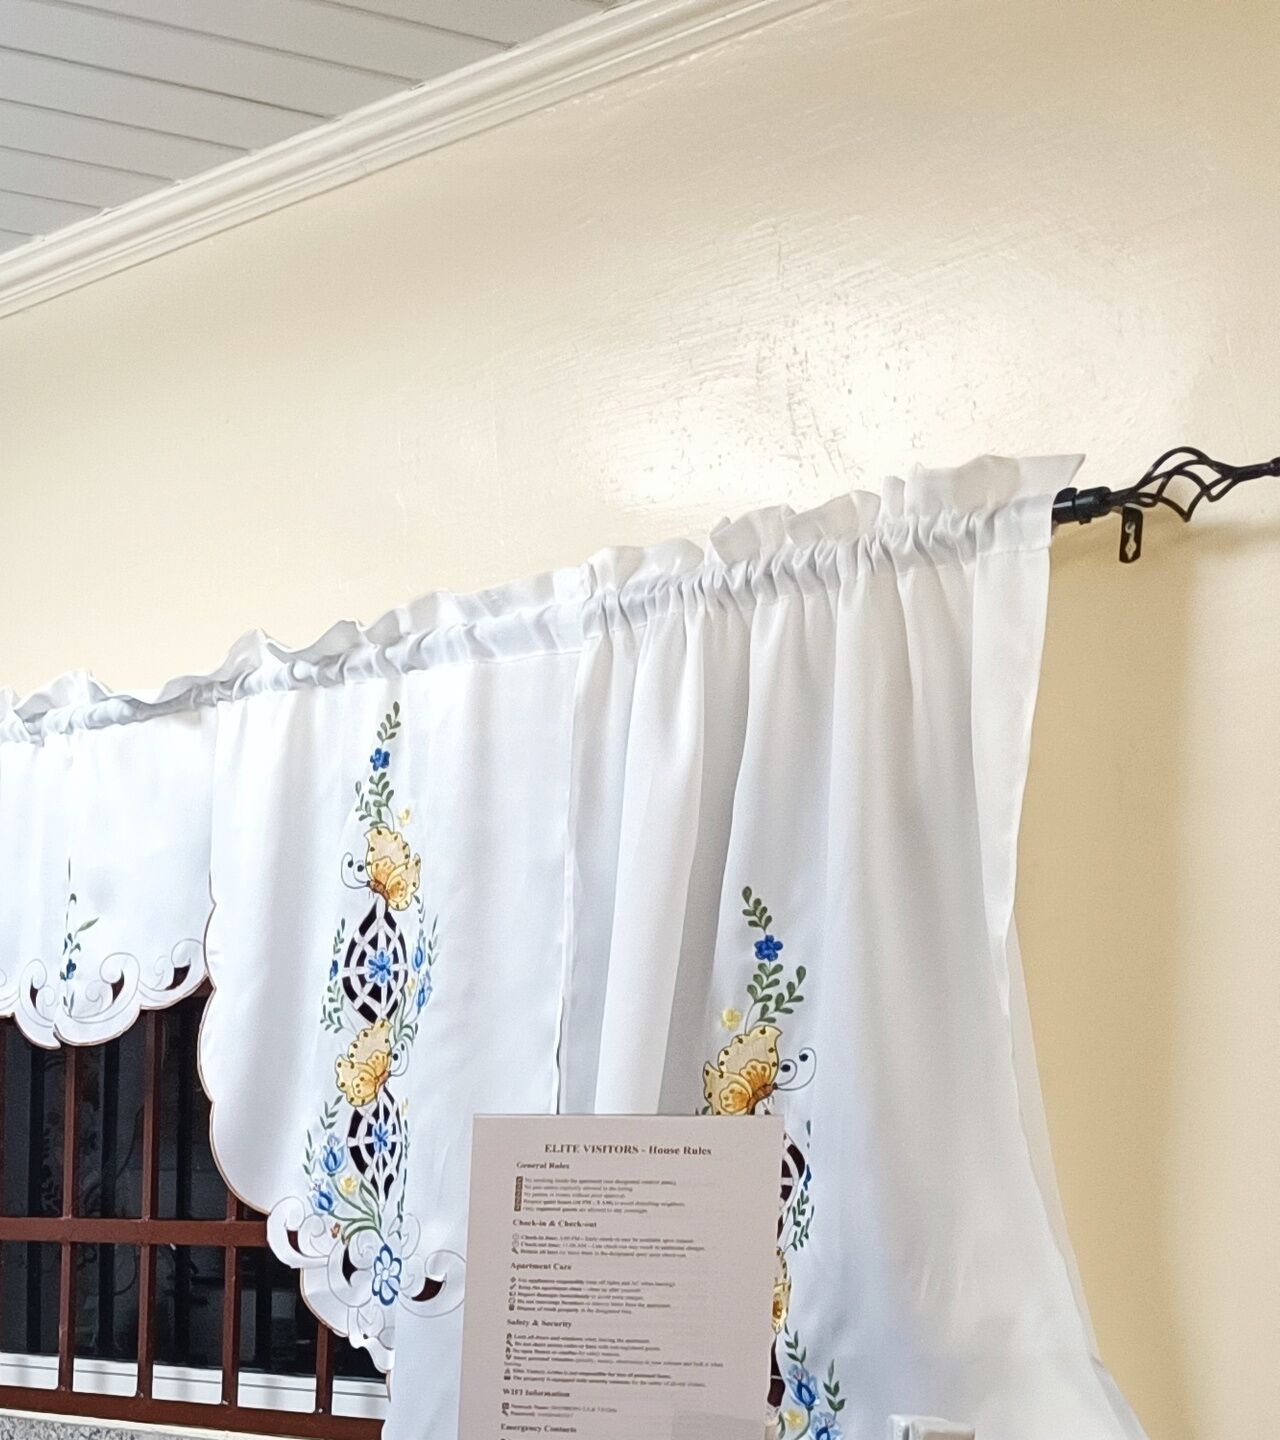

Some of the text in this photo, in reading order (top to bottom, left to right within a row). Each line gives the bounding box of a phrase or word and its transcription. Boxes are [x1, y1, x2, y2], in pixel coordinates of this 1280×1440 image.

[544, 1143, 580, 1154] ELITE
[583, 1144, 639, 1155] VISITORS
[648, 1145, 681, 1155] House
[683, 1146, 712, 1156] Rules
[516, 1161, 547, 1169] General
